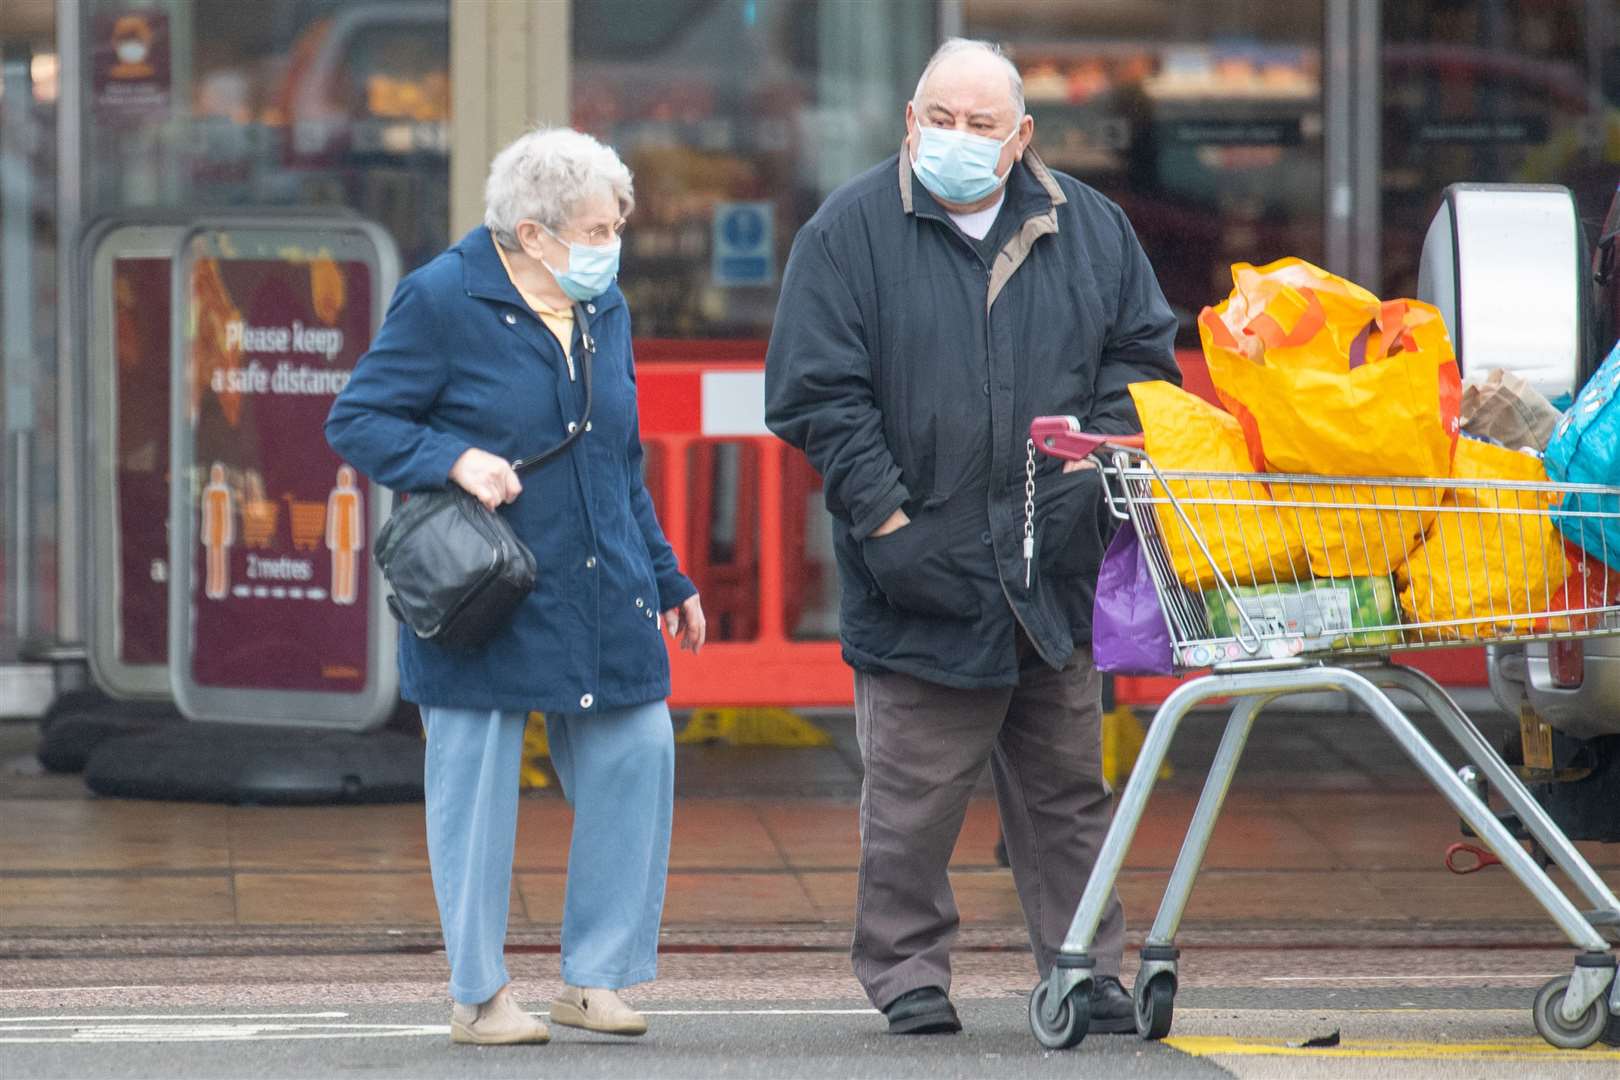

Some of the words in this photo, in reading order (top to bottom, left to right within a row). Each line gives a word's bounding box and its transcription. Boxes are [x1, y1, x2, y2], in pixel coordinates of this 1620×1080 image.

[225, 319, 289, 353] Please
[292, 319, 343, 361] keep
[210, 367, 225, 393] a
[226, 359, 270, 394] safe
[271, 359, 351, 394] distanc
[246, 553, 257, 579] 2
[257, 555, 314, 581] metres
